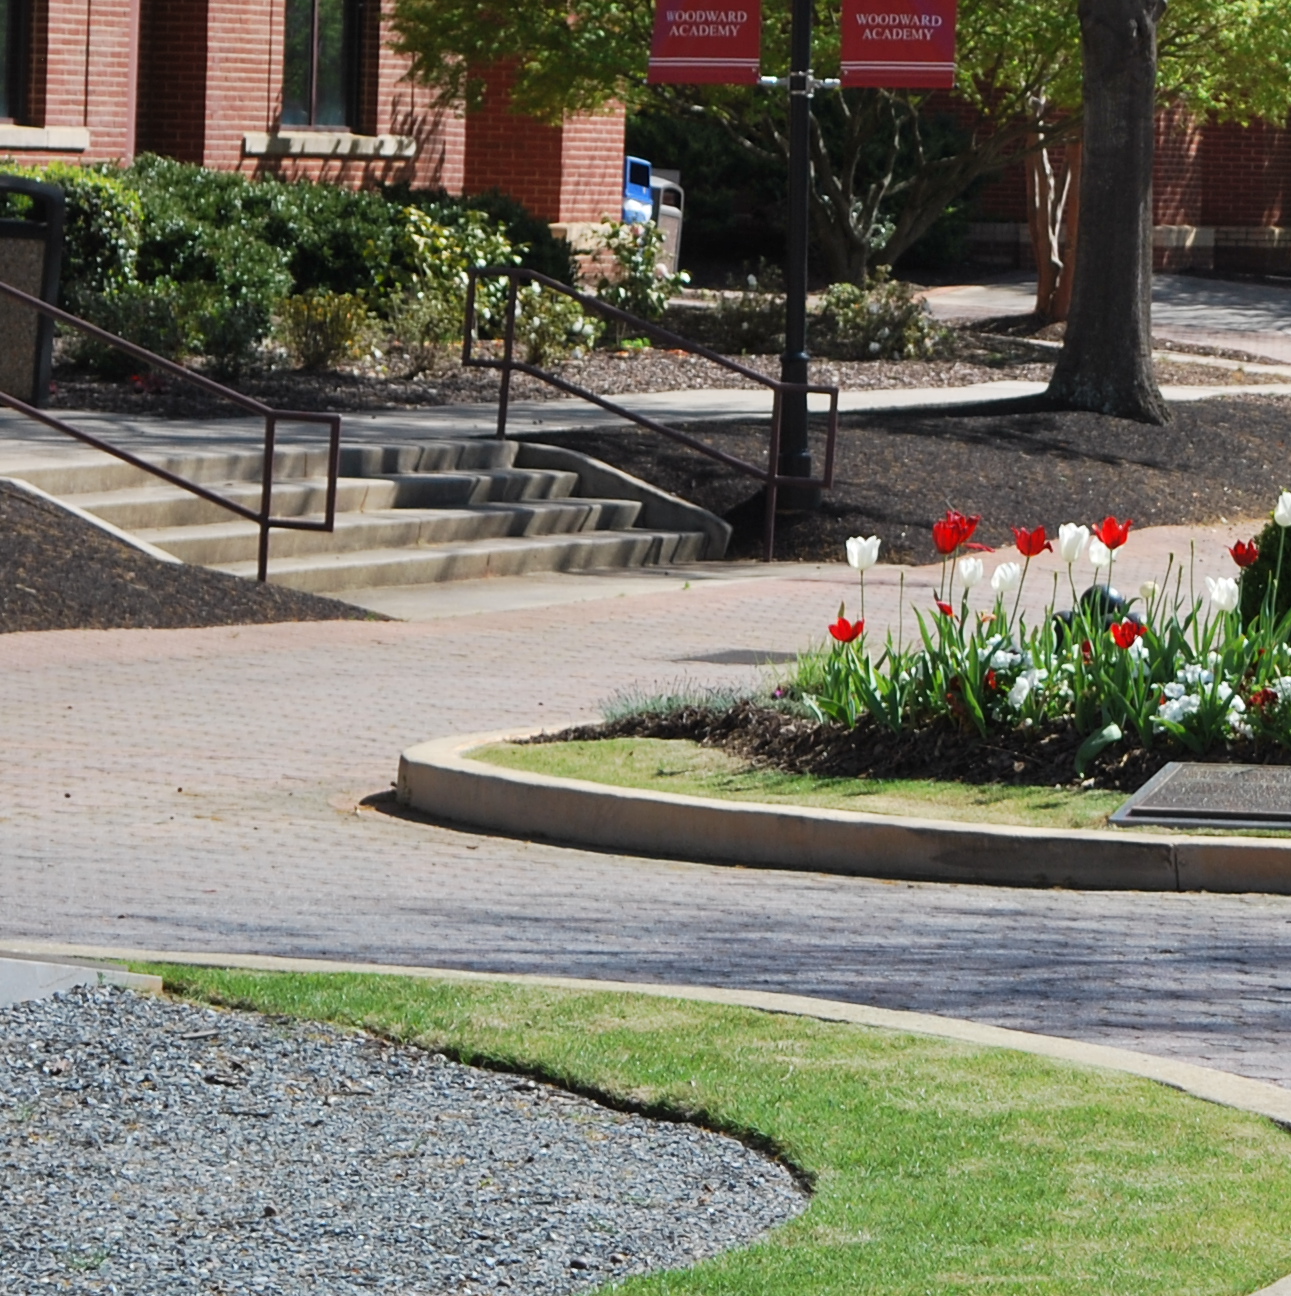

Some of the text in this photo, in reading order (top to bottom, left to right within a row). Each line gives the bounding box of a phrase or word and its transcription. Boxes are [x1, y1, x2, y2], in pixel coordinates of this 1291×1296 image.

[666, 10, 748, 23] WOODWARD
[856, 13, 943, 27] WOODWARD
[669, 24, 740, 37] ACADEMY
[862, 27, 935, 41] ACADEMY
